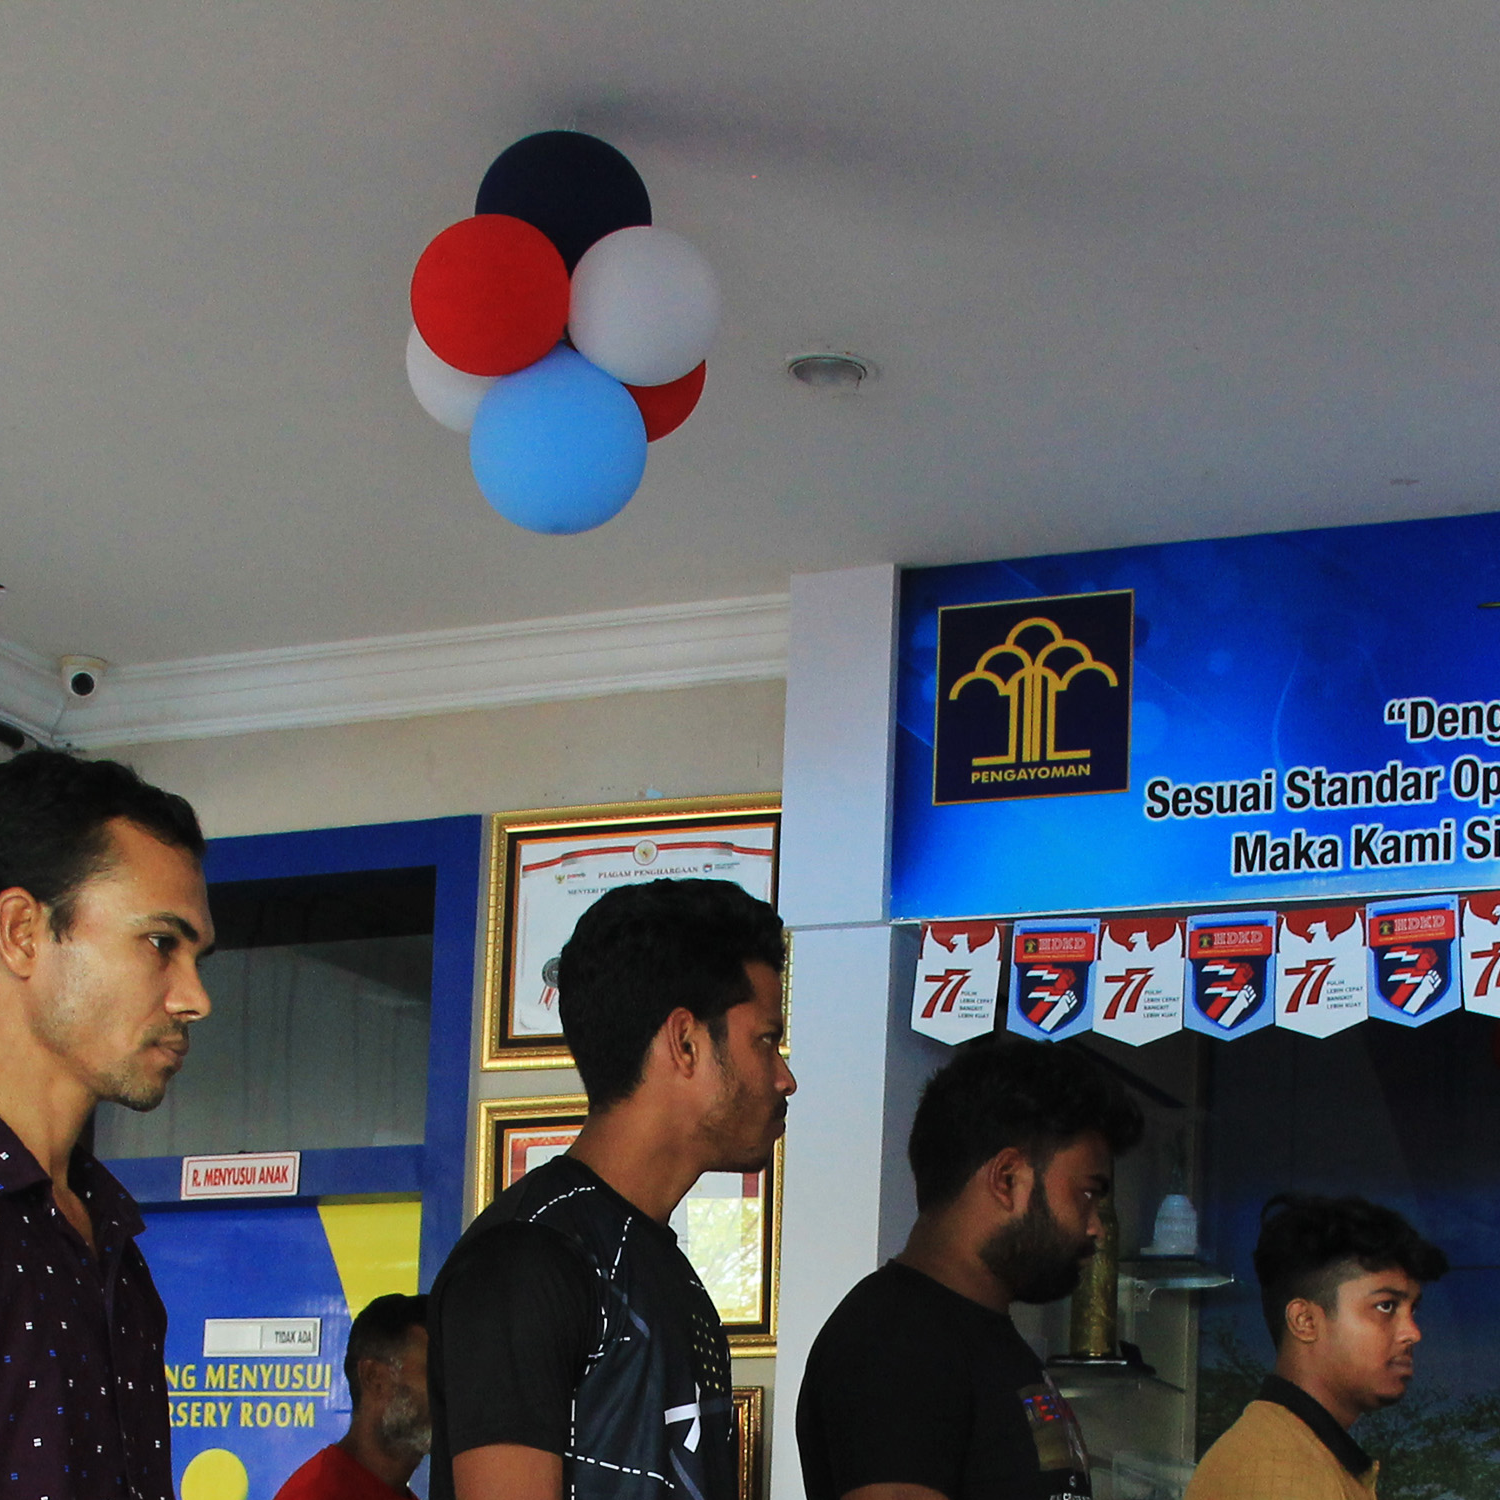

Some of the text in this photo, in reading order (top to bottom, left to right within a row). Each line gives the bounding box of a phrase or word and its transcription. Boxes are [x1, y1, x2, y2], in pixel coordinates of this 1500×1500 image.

[971, 764, 1091, 784] PENGAYOMAN
[1146, 773, 1272, 818] Sesuai
[1286, 763, 1441, 808] Standar
[1233, 833, 1339, 874] Maka
[1353, 822, 1451, 866] Kami
[1395, 915, 1445, 931] HDKD
[1039, 937, 1086, 951] HDKD
[1214, 931, 1263, 945] HDKD
[921, 969, 972, 1018] 77
[1103, 967, 1155, 1019] 77
[1285, 957, 1336, 1013] 77
[192, 1165, 289, 1187] R. MENYUSUI ANAK
[275, 1331, 295, 1343] TIDAK
[205, 1363, 332, 1389] MENYUSUI
[240, 1402, 315, 1427] ROOM
